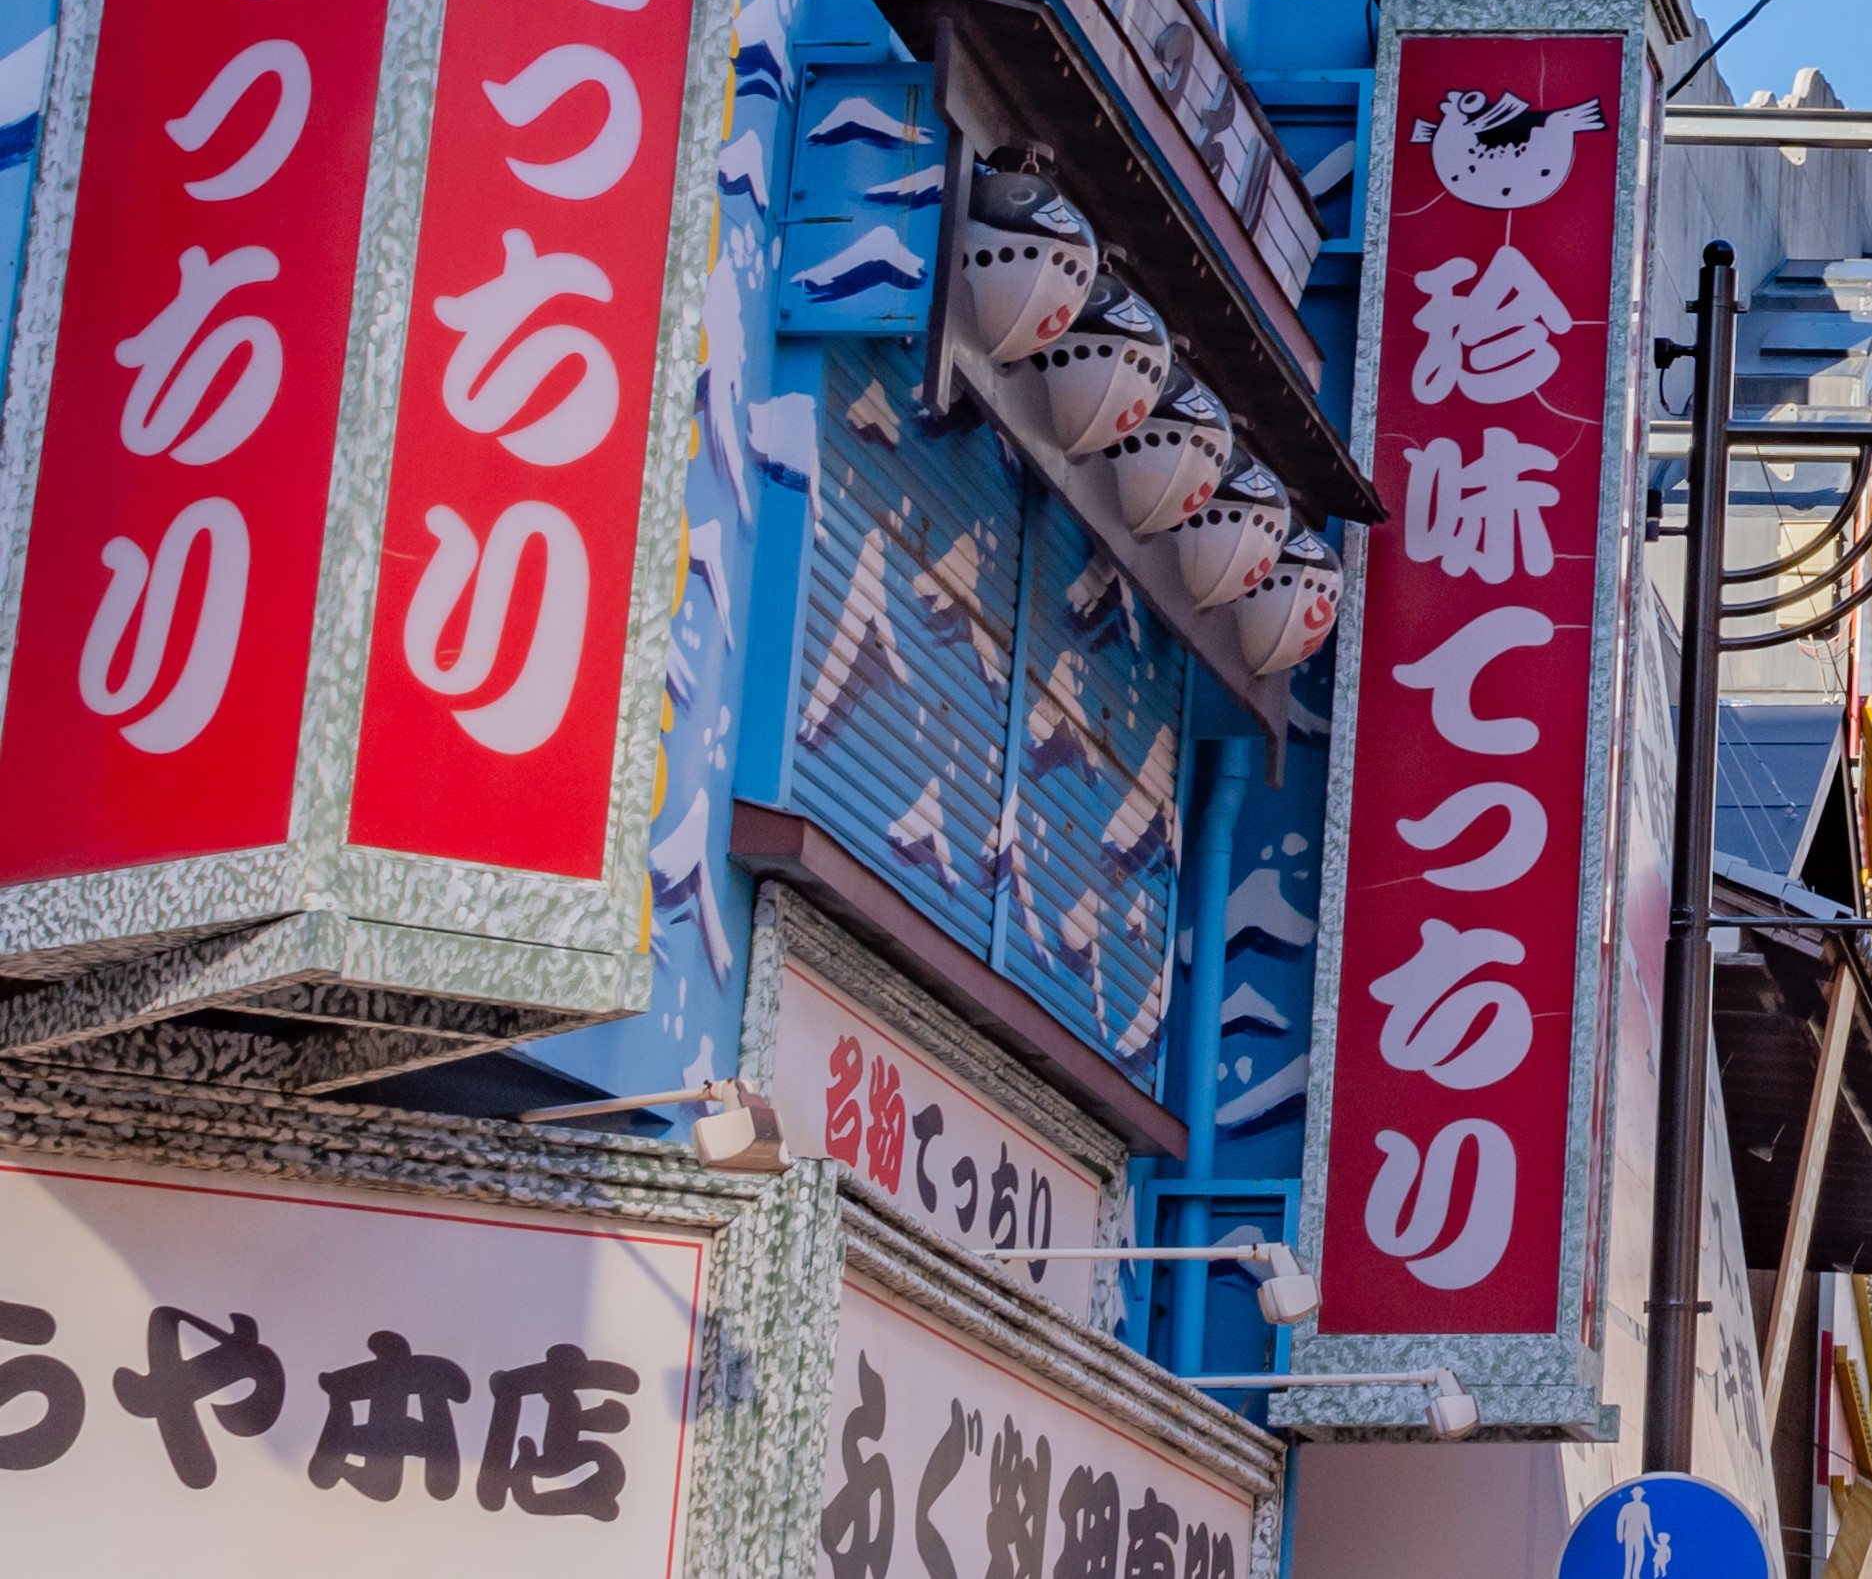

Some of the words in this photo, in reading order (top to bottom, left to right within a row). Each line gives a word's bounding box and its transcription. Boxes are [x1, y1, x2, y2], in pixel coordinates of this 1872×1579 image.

[1364, 246, 1574, 1290] 珍味てっちり
